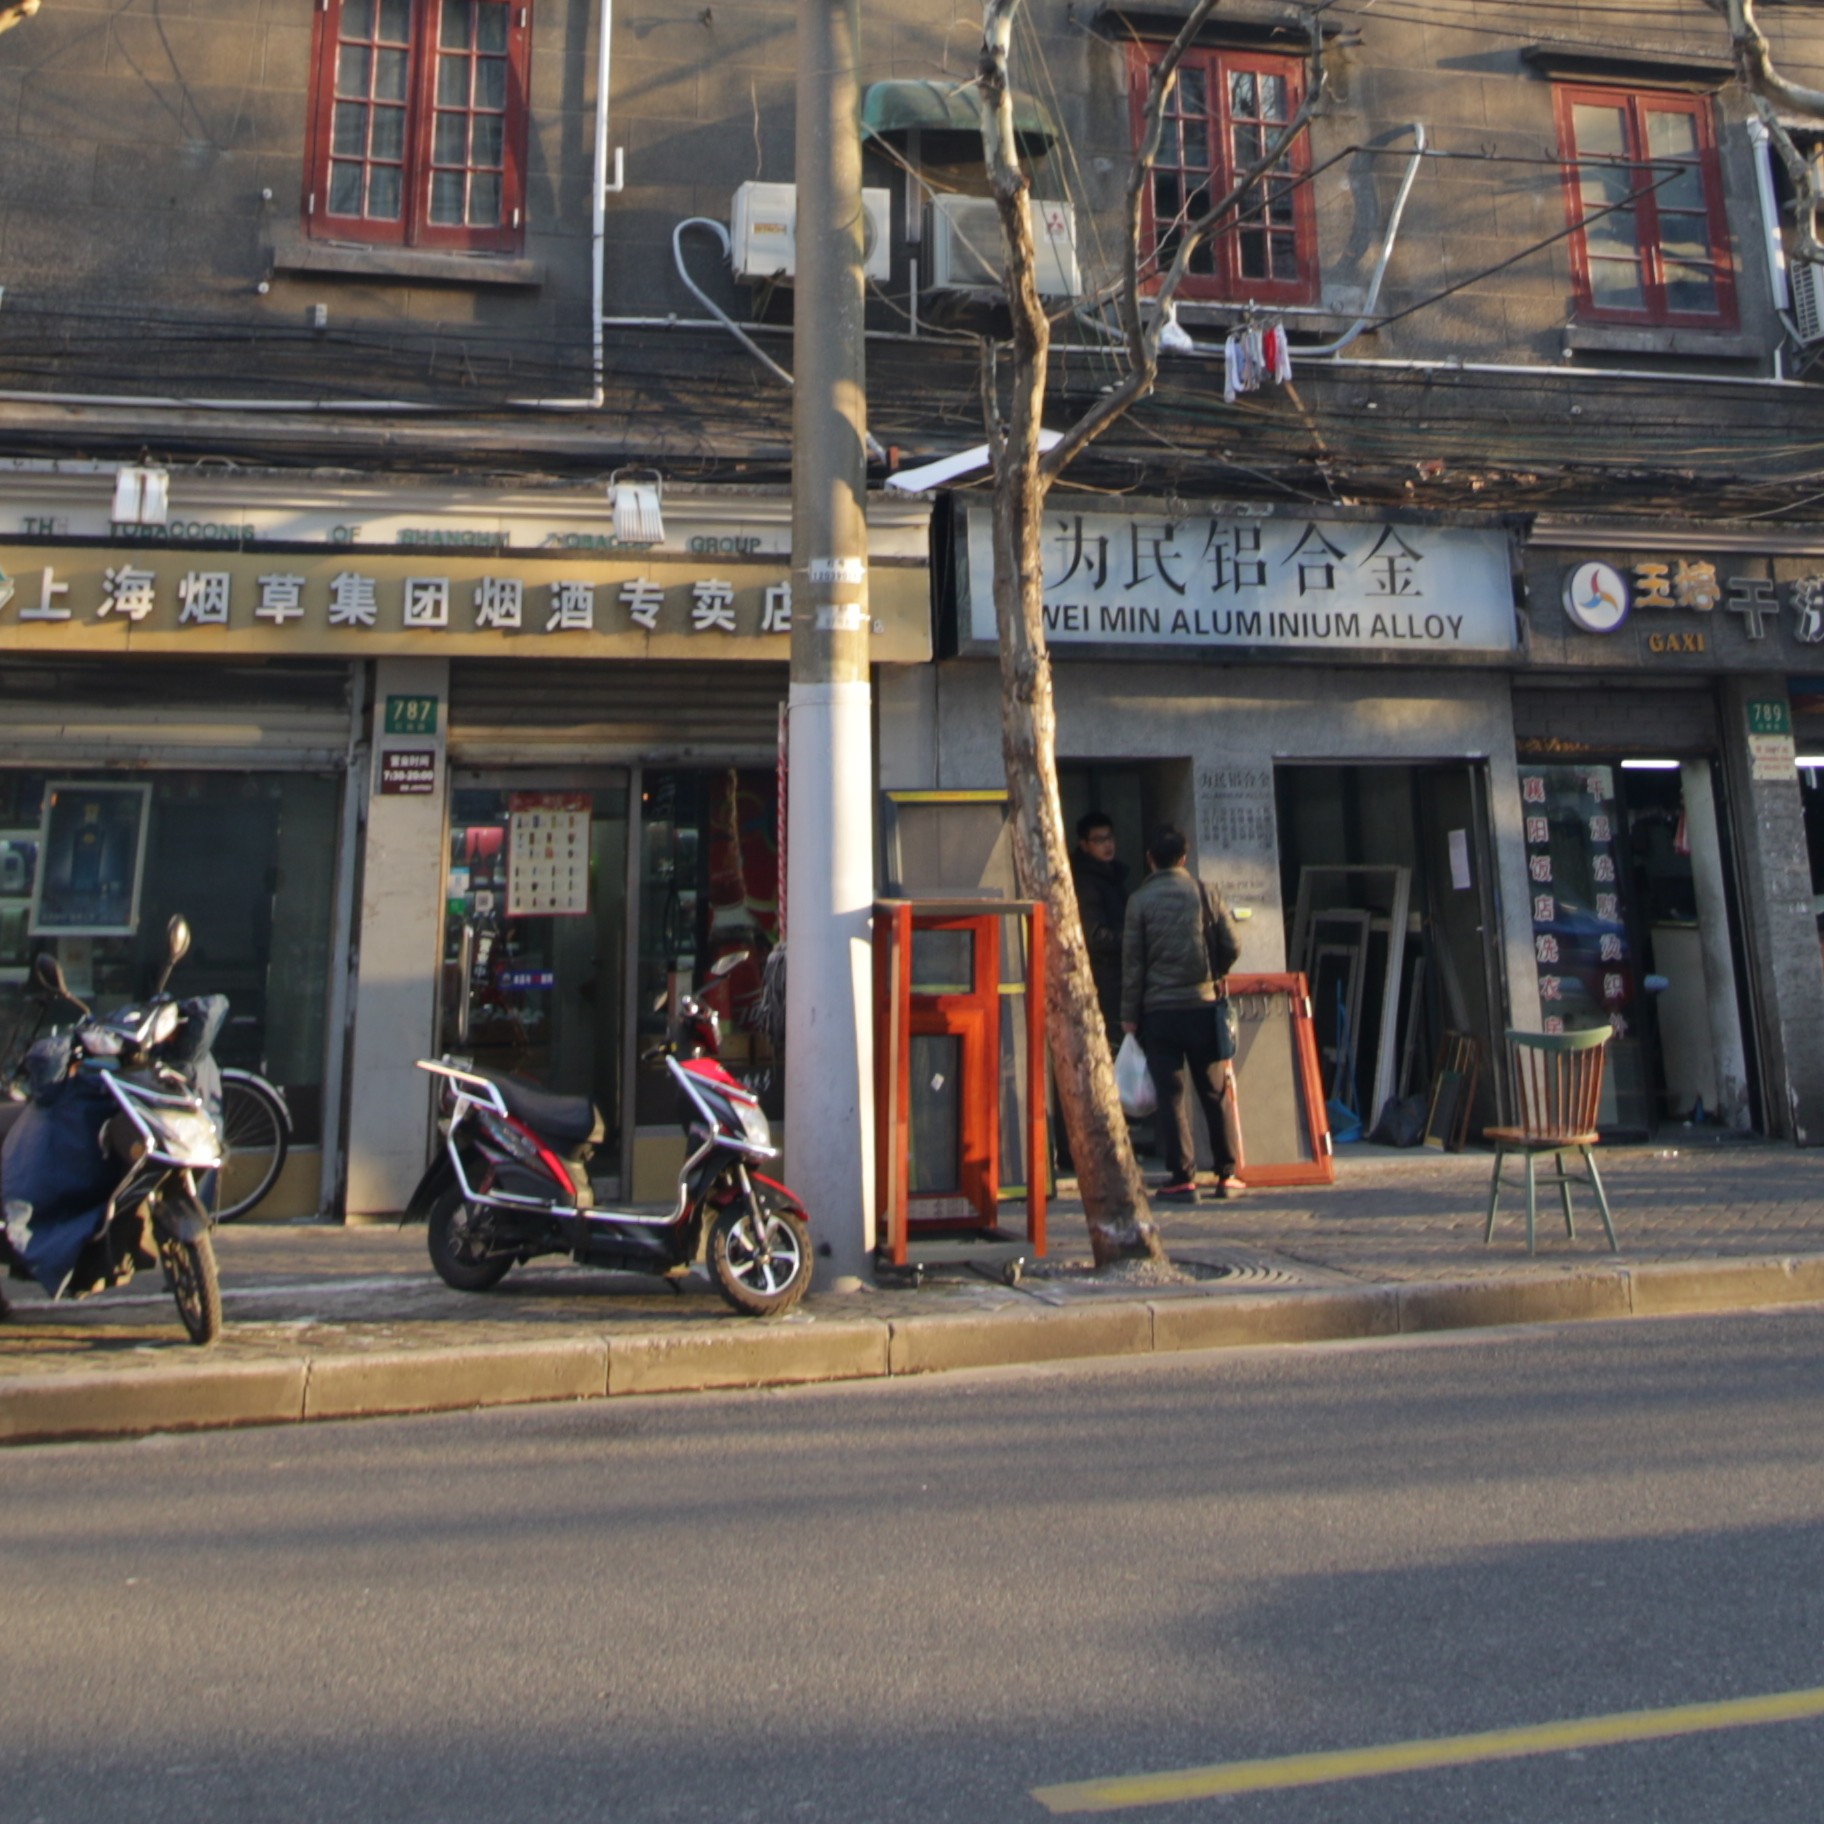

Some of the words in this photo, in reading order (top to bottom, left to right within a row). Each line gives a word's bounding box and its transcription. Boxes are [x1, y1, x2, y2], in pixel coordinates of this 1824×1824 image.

[332, 526, 361, 543] OF
[690, 535, 762, 554] GROUP
[1045, 516, 1425, 599] 为民铝合金
[1043, 604, 1090, 632] WEI
[1100, 606, 1160, 634] MIN
[1370, 613, 1464, 640] ALLOY
[1648, 632, 1706, 652] GAXI
[393, 700, 432, 720] 787
[1753, 703, 1782, 722] 789
